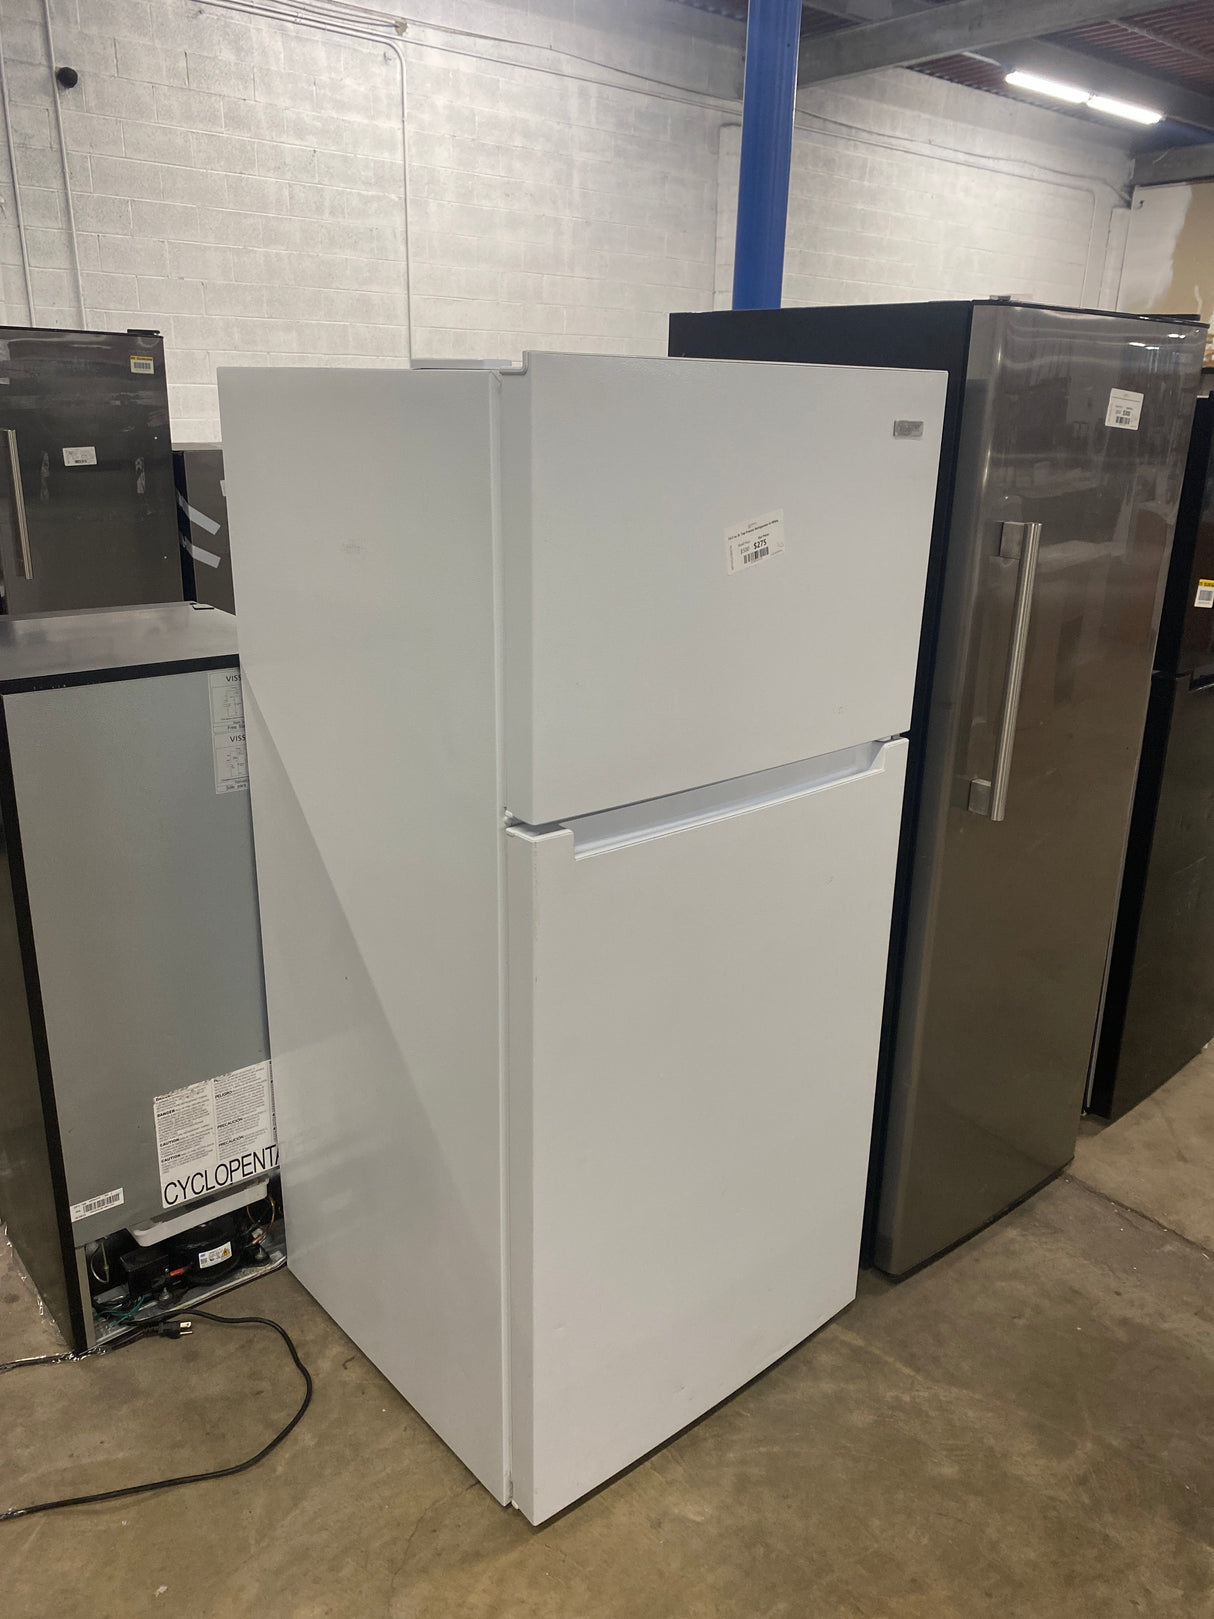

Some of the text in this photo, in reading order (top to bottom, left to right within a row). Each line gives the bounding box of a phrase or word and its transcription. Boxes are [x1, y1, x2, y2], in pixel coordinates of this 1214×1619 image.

[753, 538, 767, 550] $275
[160, 1138, 179, 1148] CAUTION
[161, 1154, 181, 1163] CAUTION
